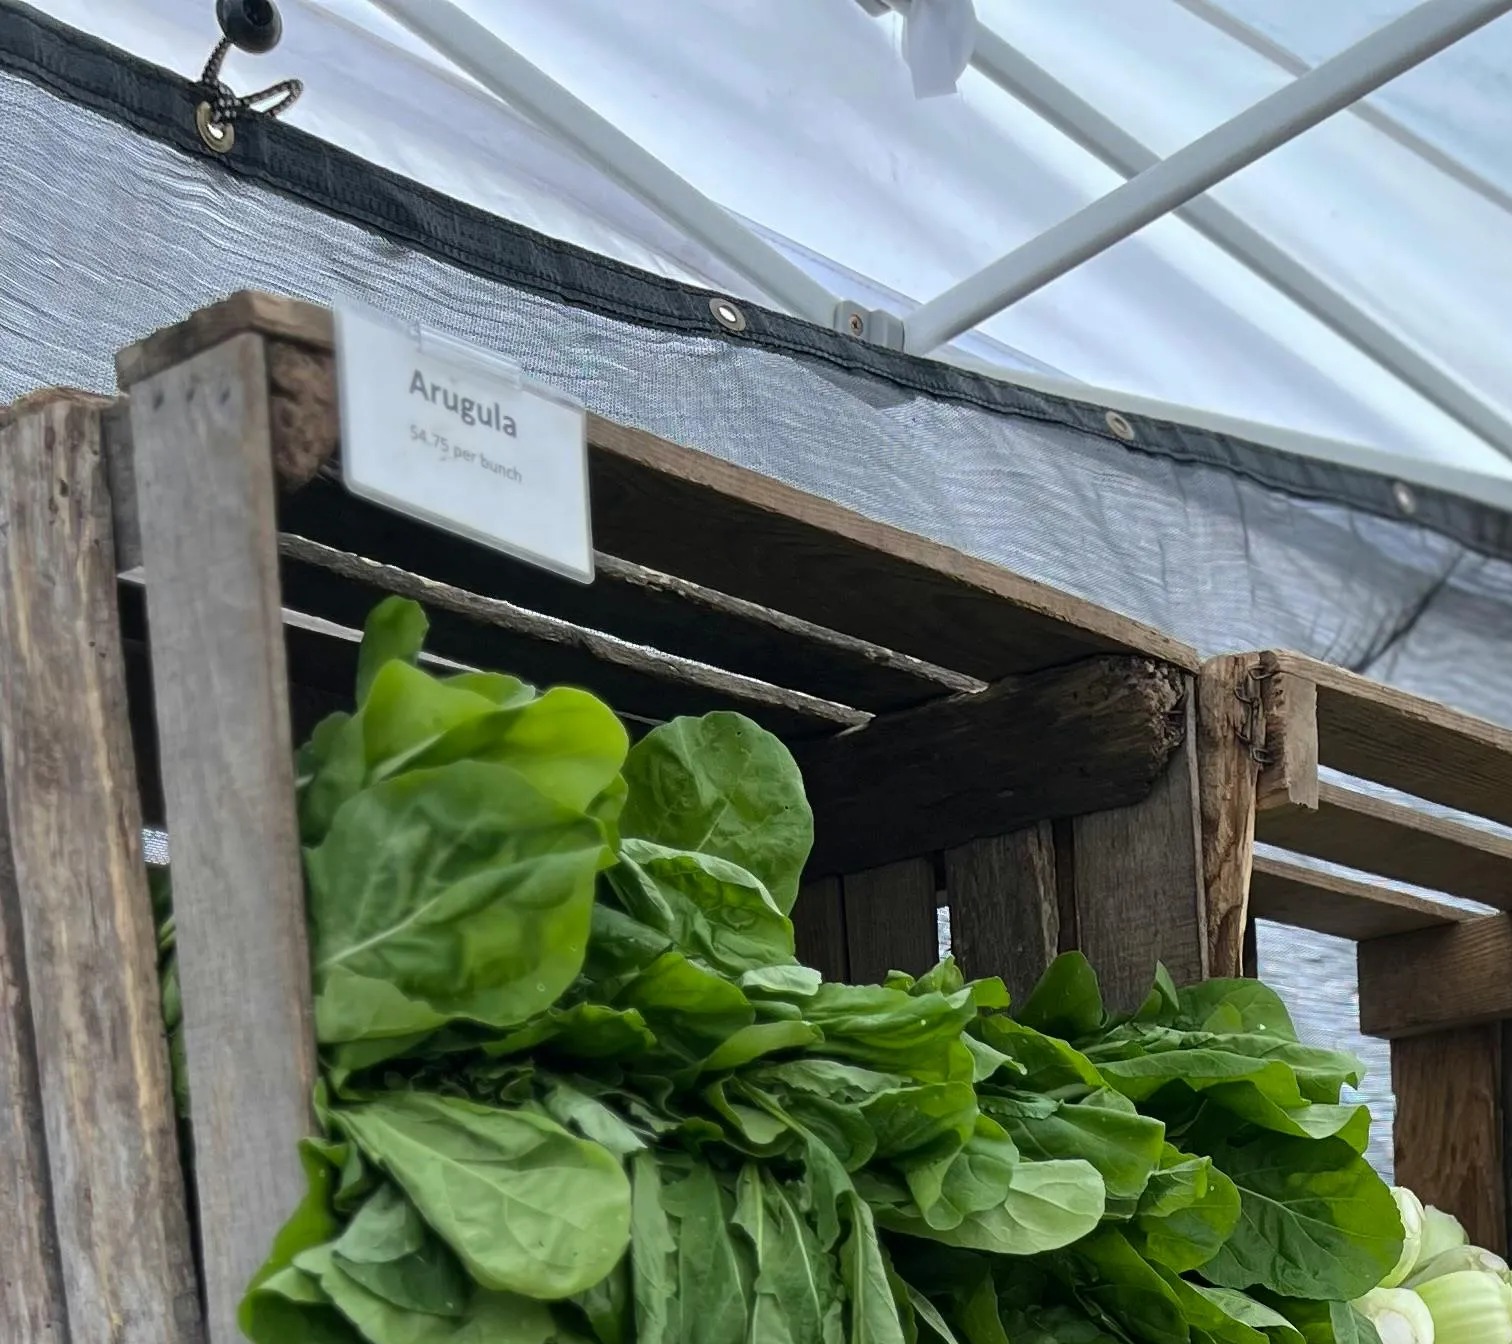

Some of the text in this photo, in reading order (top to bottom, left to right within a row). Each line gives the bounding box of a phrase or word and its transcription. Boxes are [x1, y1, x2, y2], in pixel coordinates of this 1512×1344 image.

[409, 369, 517, 438] Arugula
[410, 424, 522, 483] $4.75 per bunch
